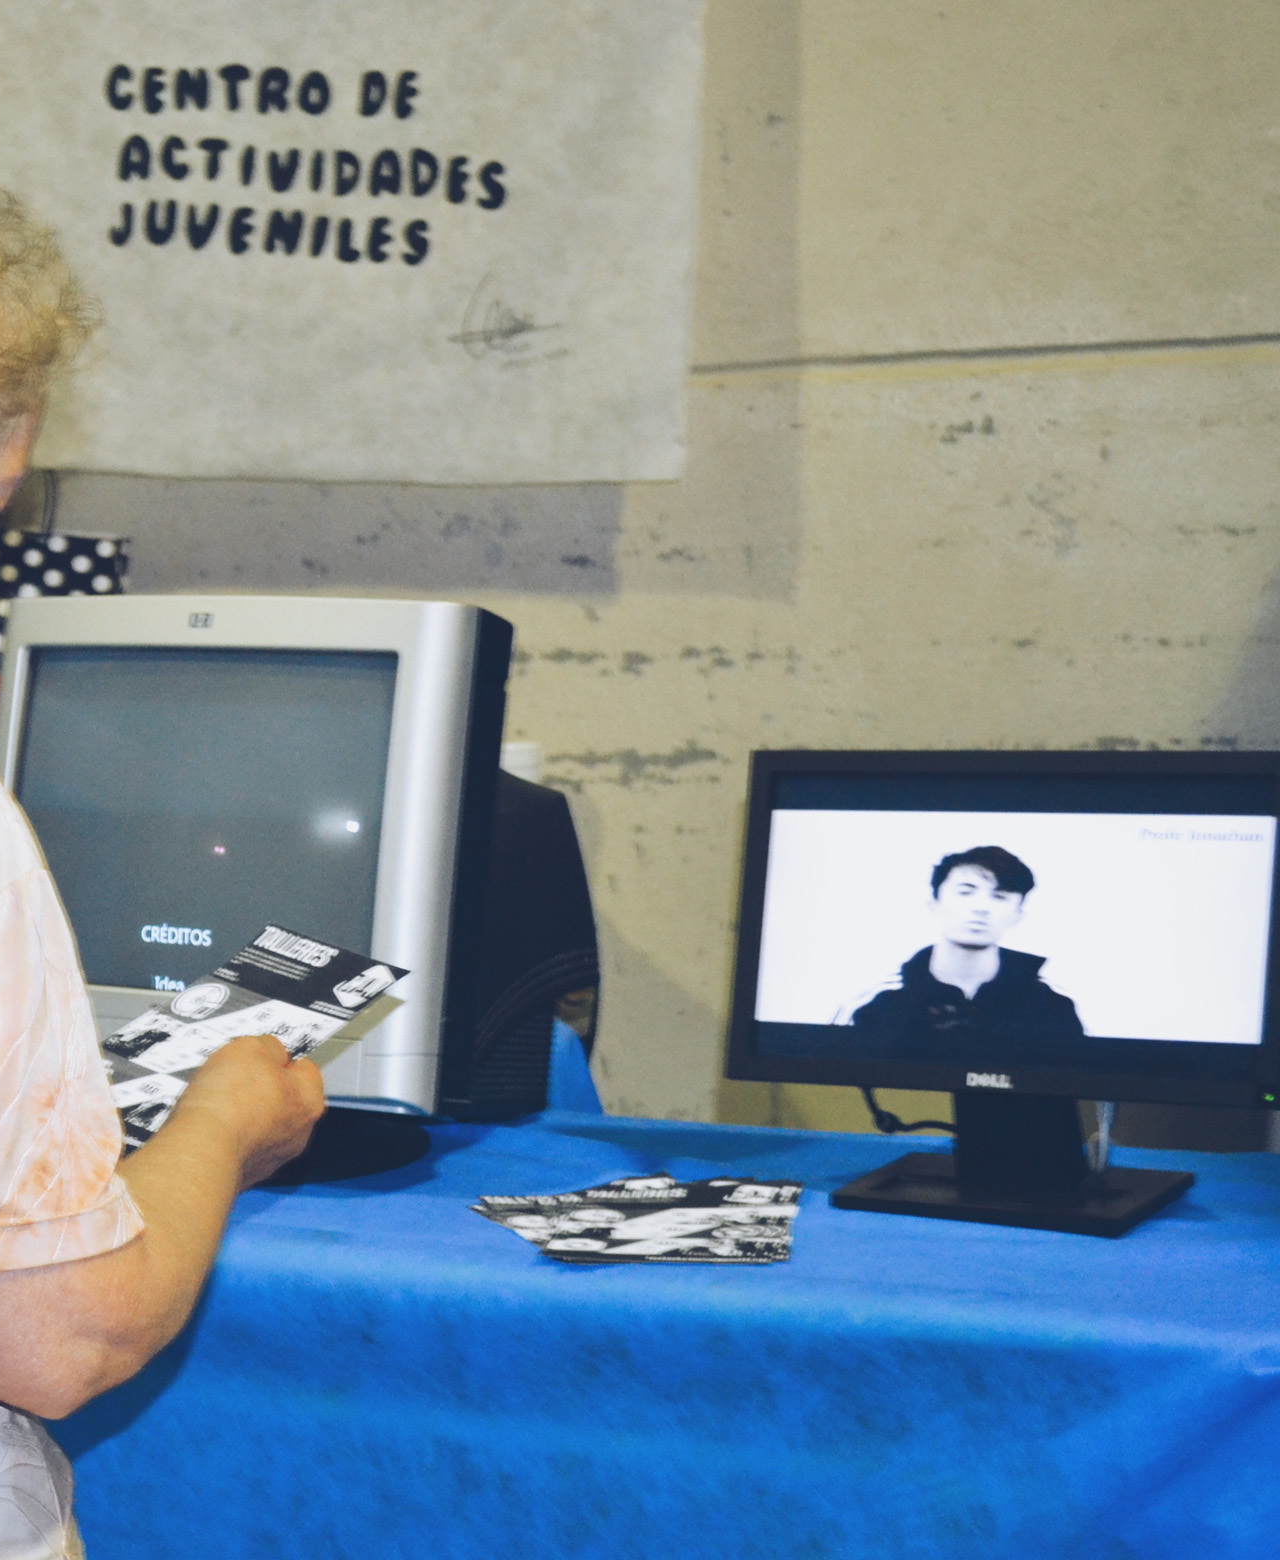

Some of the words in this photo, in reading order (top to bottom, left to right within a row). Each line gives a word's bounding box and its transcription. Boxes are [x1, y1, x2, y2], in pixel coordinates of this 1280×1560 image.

[106, 63, 331, 115] CENTRO
[359, 70, 419, 119] DE
[117, 135, 506, 210] ACTIVIDADES
[109, 200, 429, 265] JUVENILES
[141, 922, 212, 947] CRÉDITOS
[966, 1072, 1013, 1089] DELL
